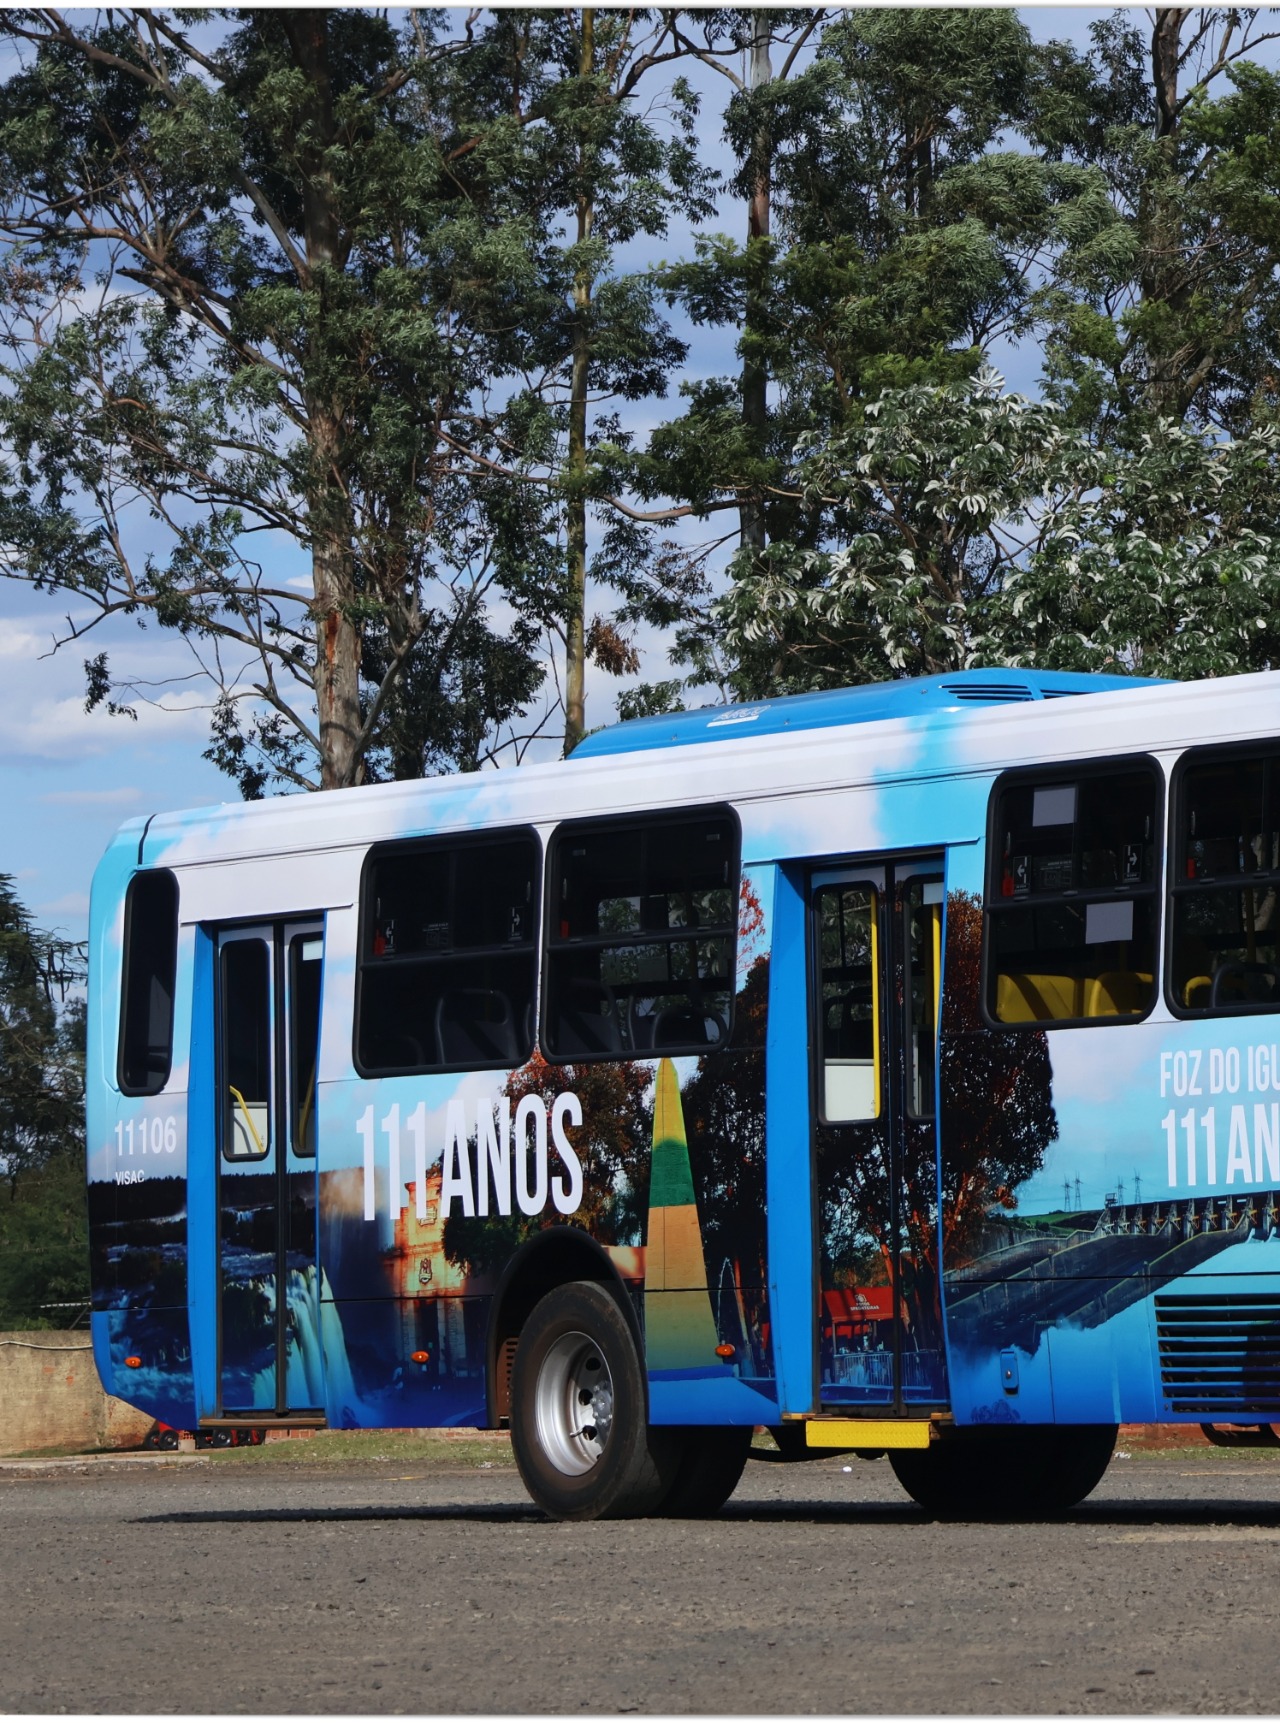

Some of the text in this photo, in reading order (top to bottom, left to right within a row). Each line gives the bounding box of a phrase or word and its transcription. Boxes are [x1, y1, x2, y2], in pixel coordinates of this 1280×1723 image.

[1160, 1049, 1203, 1098] FOZ
[1209, 1046, 1241, 1094] DO
[114, 1115, 177, 1157] 11106
[356, 1091, 584, 1221] 111 ANOS
[1161, 1106, 1217, 1187] 111
[115, 1169, 145, 1186] VISAC
